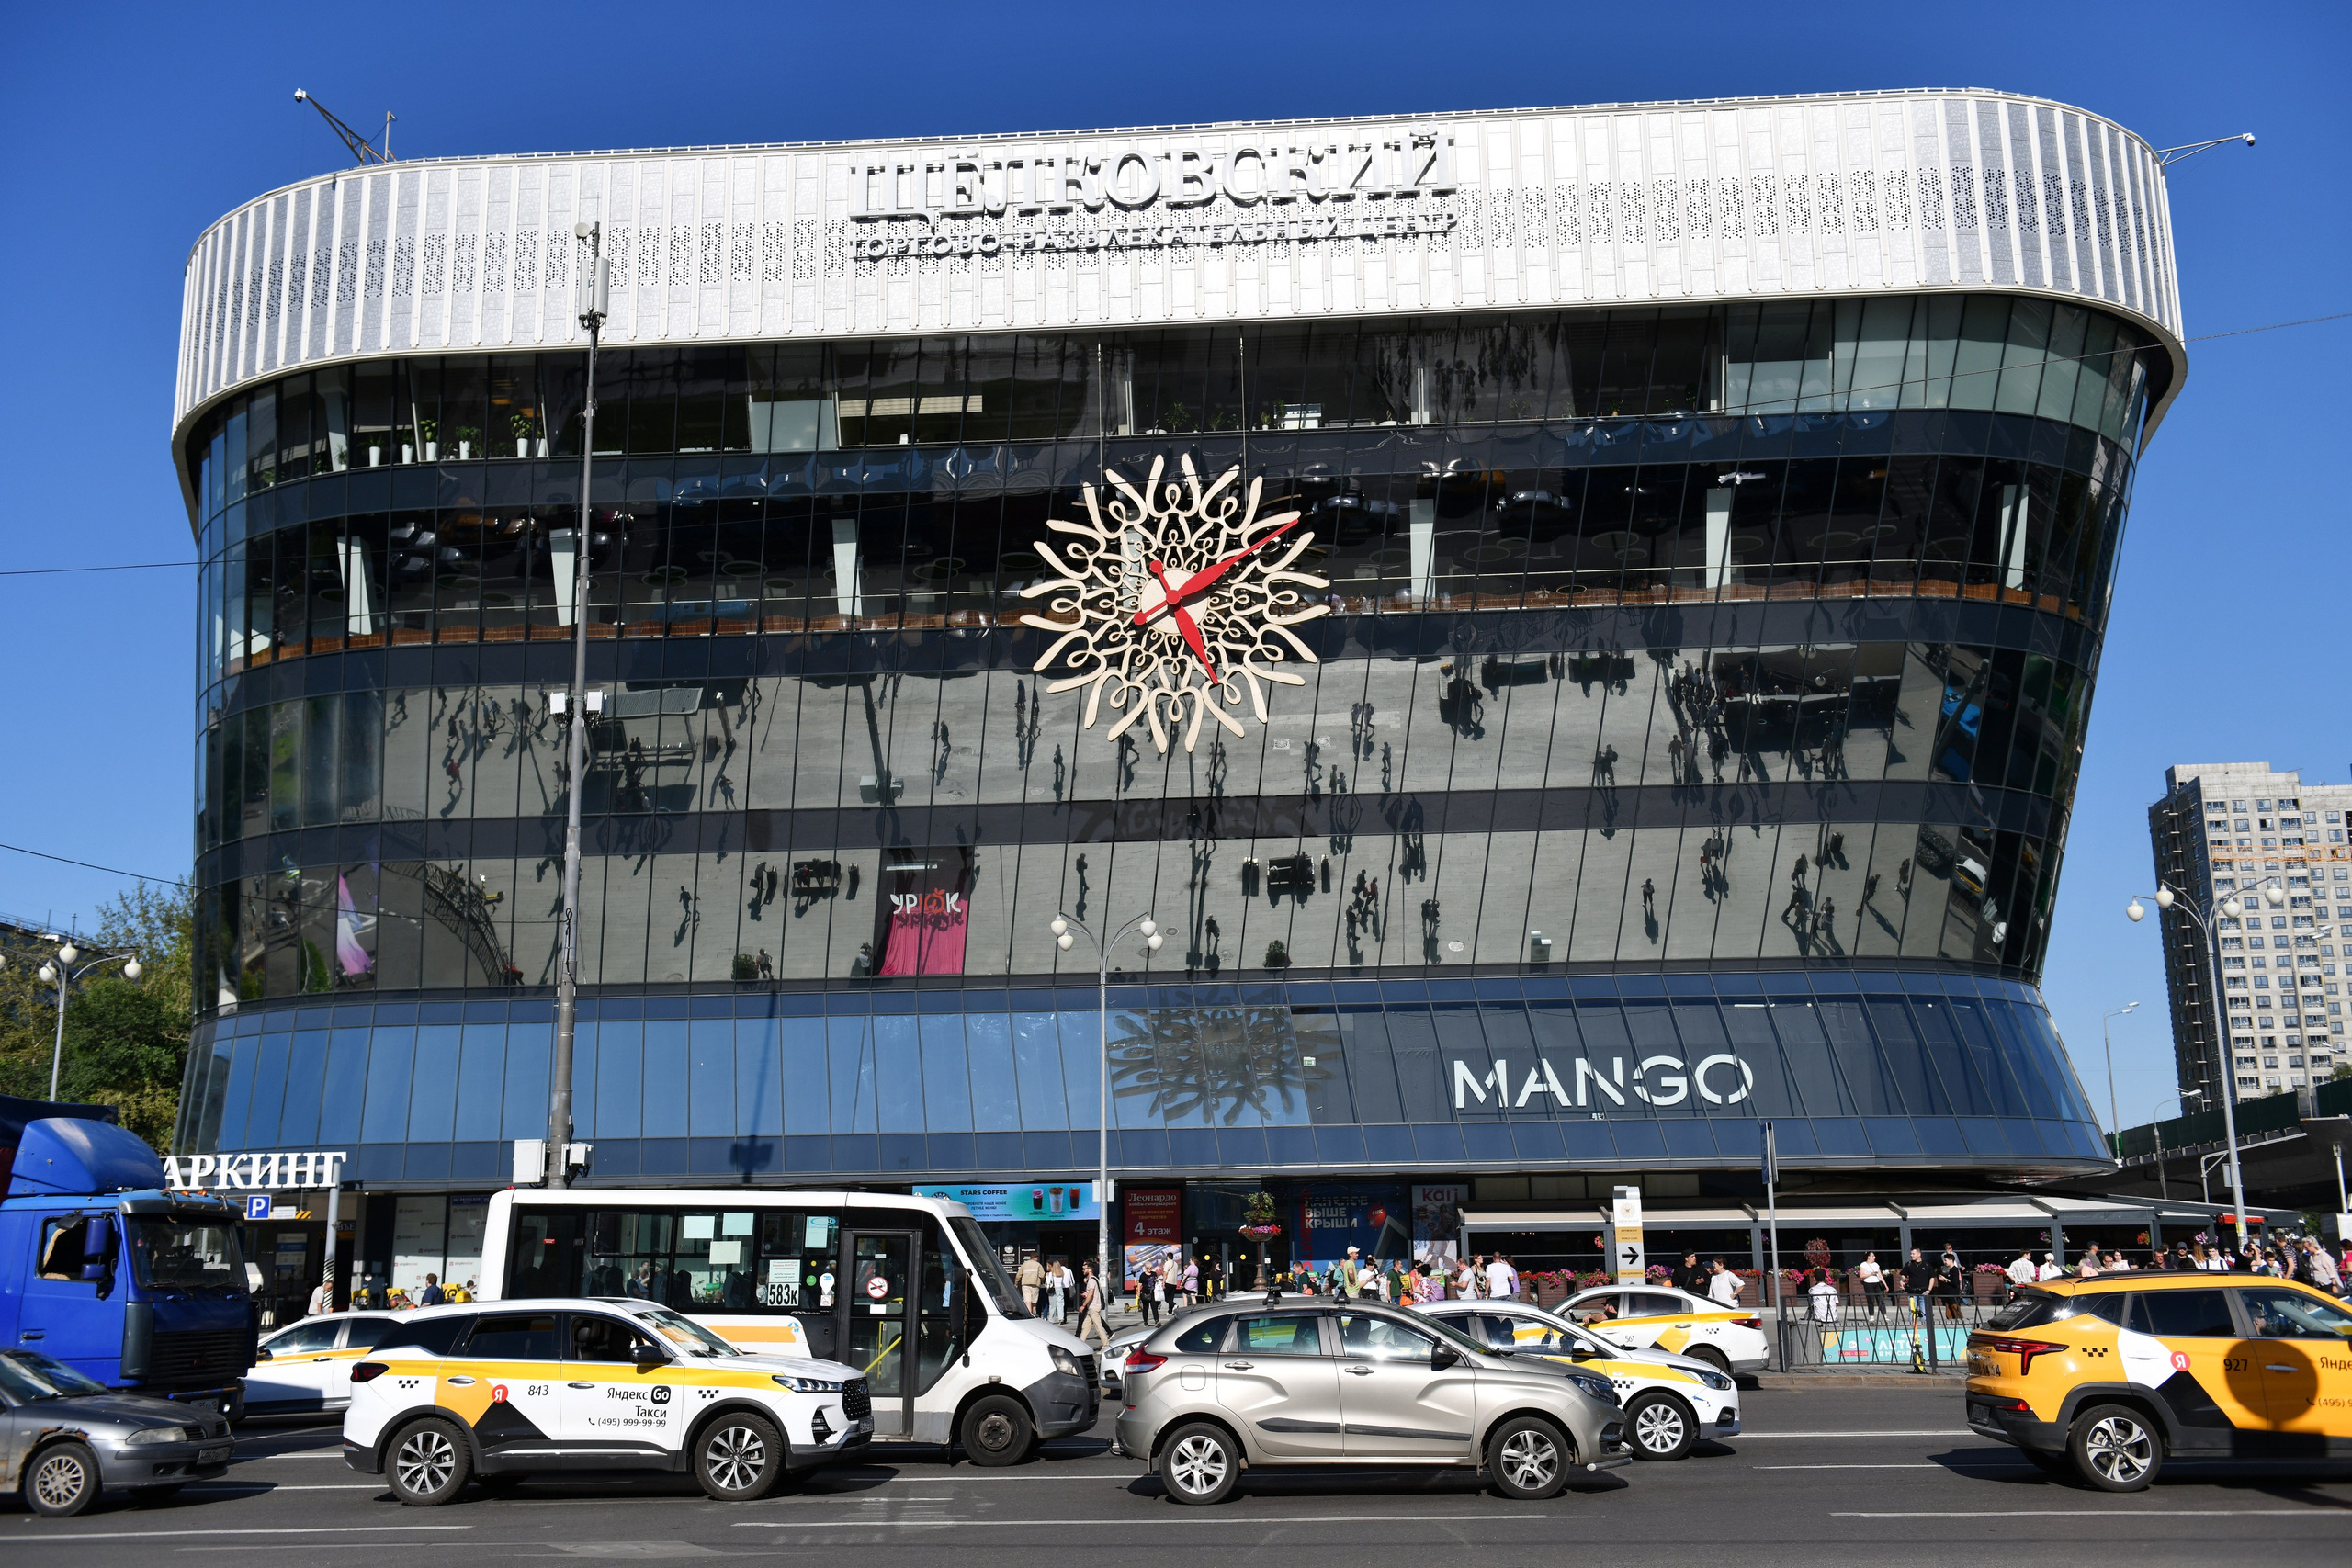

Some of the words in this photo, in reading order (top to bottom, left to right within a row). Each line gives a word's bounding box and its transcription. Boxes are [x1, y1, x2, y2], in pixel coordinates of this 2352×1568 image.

[849, 120, 1457, 230] ЩЁЛКОВСКИЙ
[1358, 209, 1458, 237] ЦЕНТР
[1453, 1054, 1754, 1109] MANGO
[163, 1152, 347, 1190] АРКИНГ
[1128, 1193, 1177, 1202] Леонардо
[1422, 1186, 1459, 1202] kari
[252, 1198, 266, 1217] P
[1305, 1207, 1346, 1218] ВЫШЕ
[1134, 1221, 1145, 1235] 4
[1305, 1217, 1358, 1229] КРЫШИ
[769, 1283, 798, 1305] 583к
[1625, 1335, 1635, 1343] 561
[2176, 1355, 2187, 1368] Я
[2223, 1359, 2247, 1371] 927
[2320, 1357, 2352, 1371] Янде
[494, 1388, 503, 1402] Я
[528, 1385, 548, 1396] 843
[607, 1388, 649, 1400] Яндекс
[652, 1389, 670, 1402] Go
[2318, 1398, 2345, 1407] (495)
[635, 1405, 667, 1418] Такси
[598, 1417, 621, 1427] (495)
[623, 1418, 667, 1427] 999-99-99
